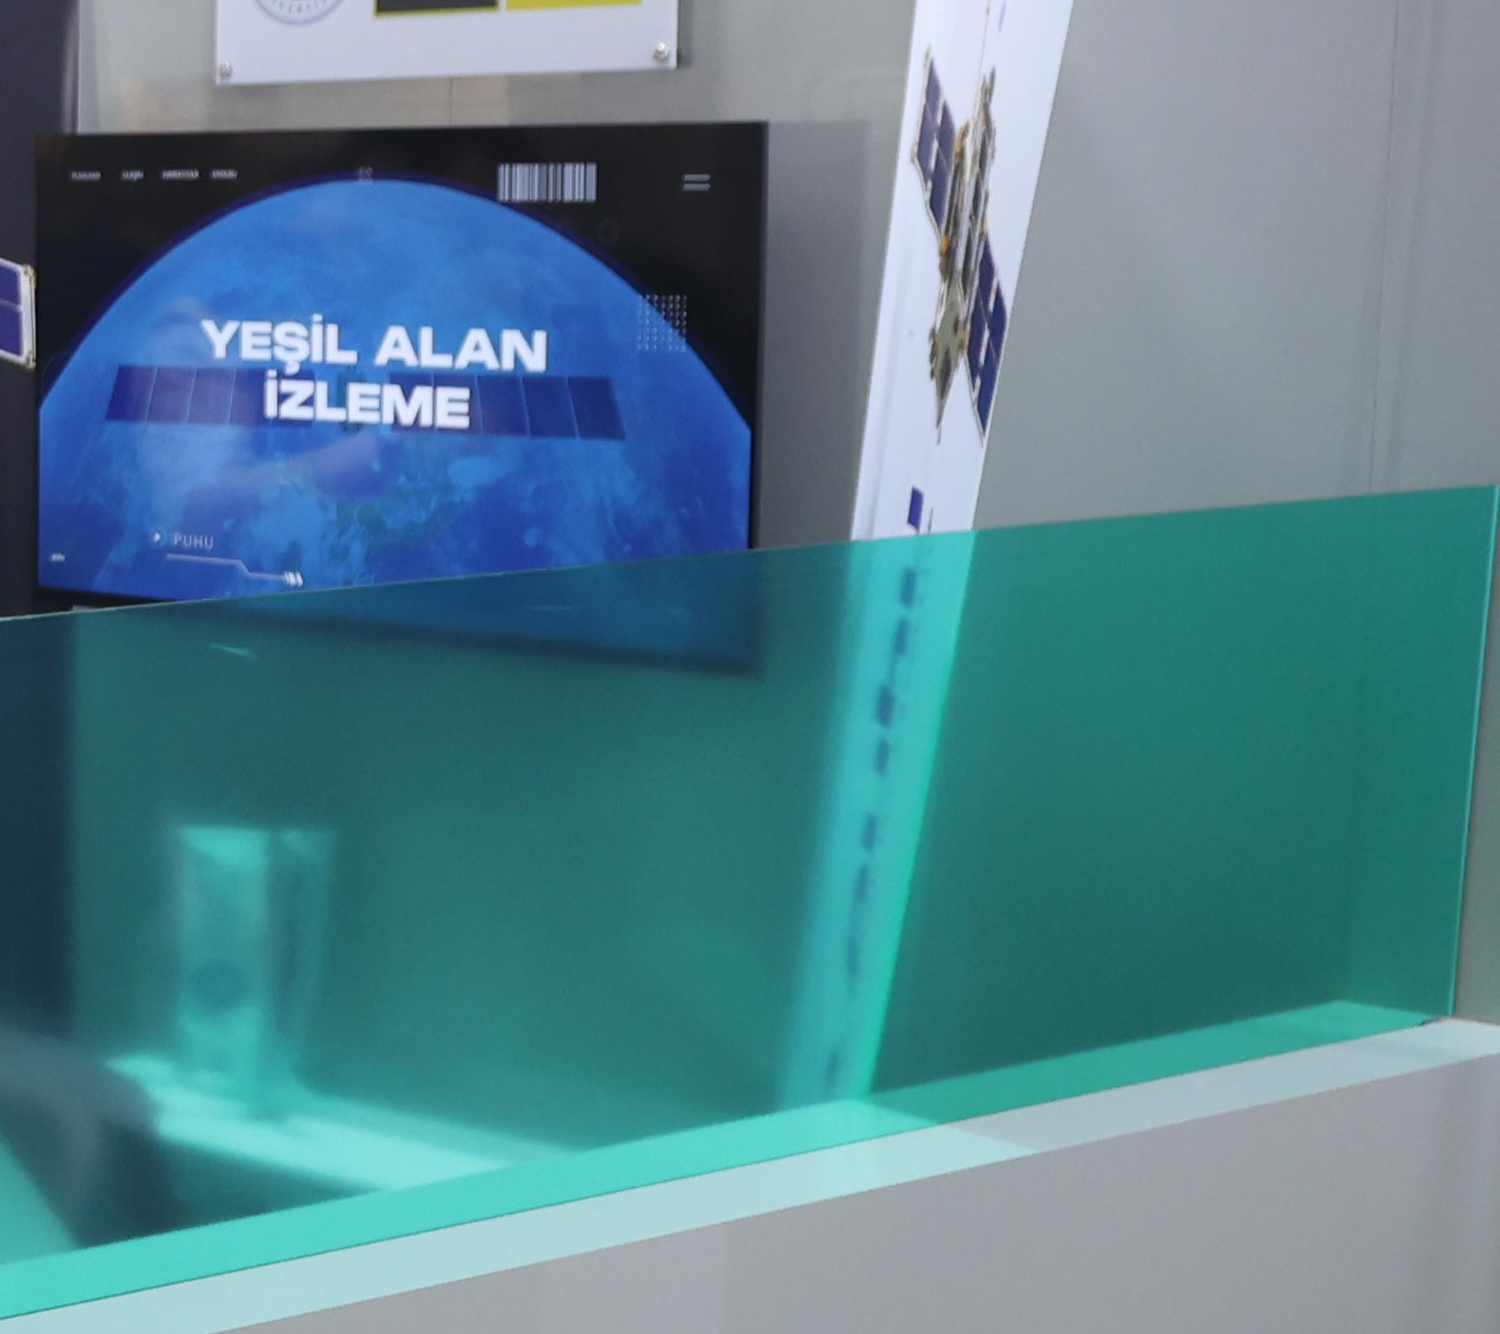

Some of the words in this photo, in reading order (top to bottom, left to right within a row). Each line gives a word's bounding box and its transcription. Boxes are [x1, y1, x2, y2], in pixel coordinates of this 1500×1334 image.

[201, 313, 358, 376] YEŞİL
[374, 324, 548, 373] ALAN
[263, 369, 471, 429] İZLEME
[171, 532, 215, 550] PUHU
